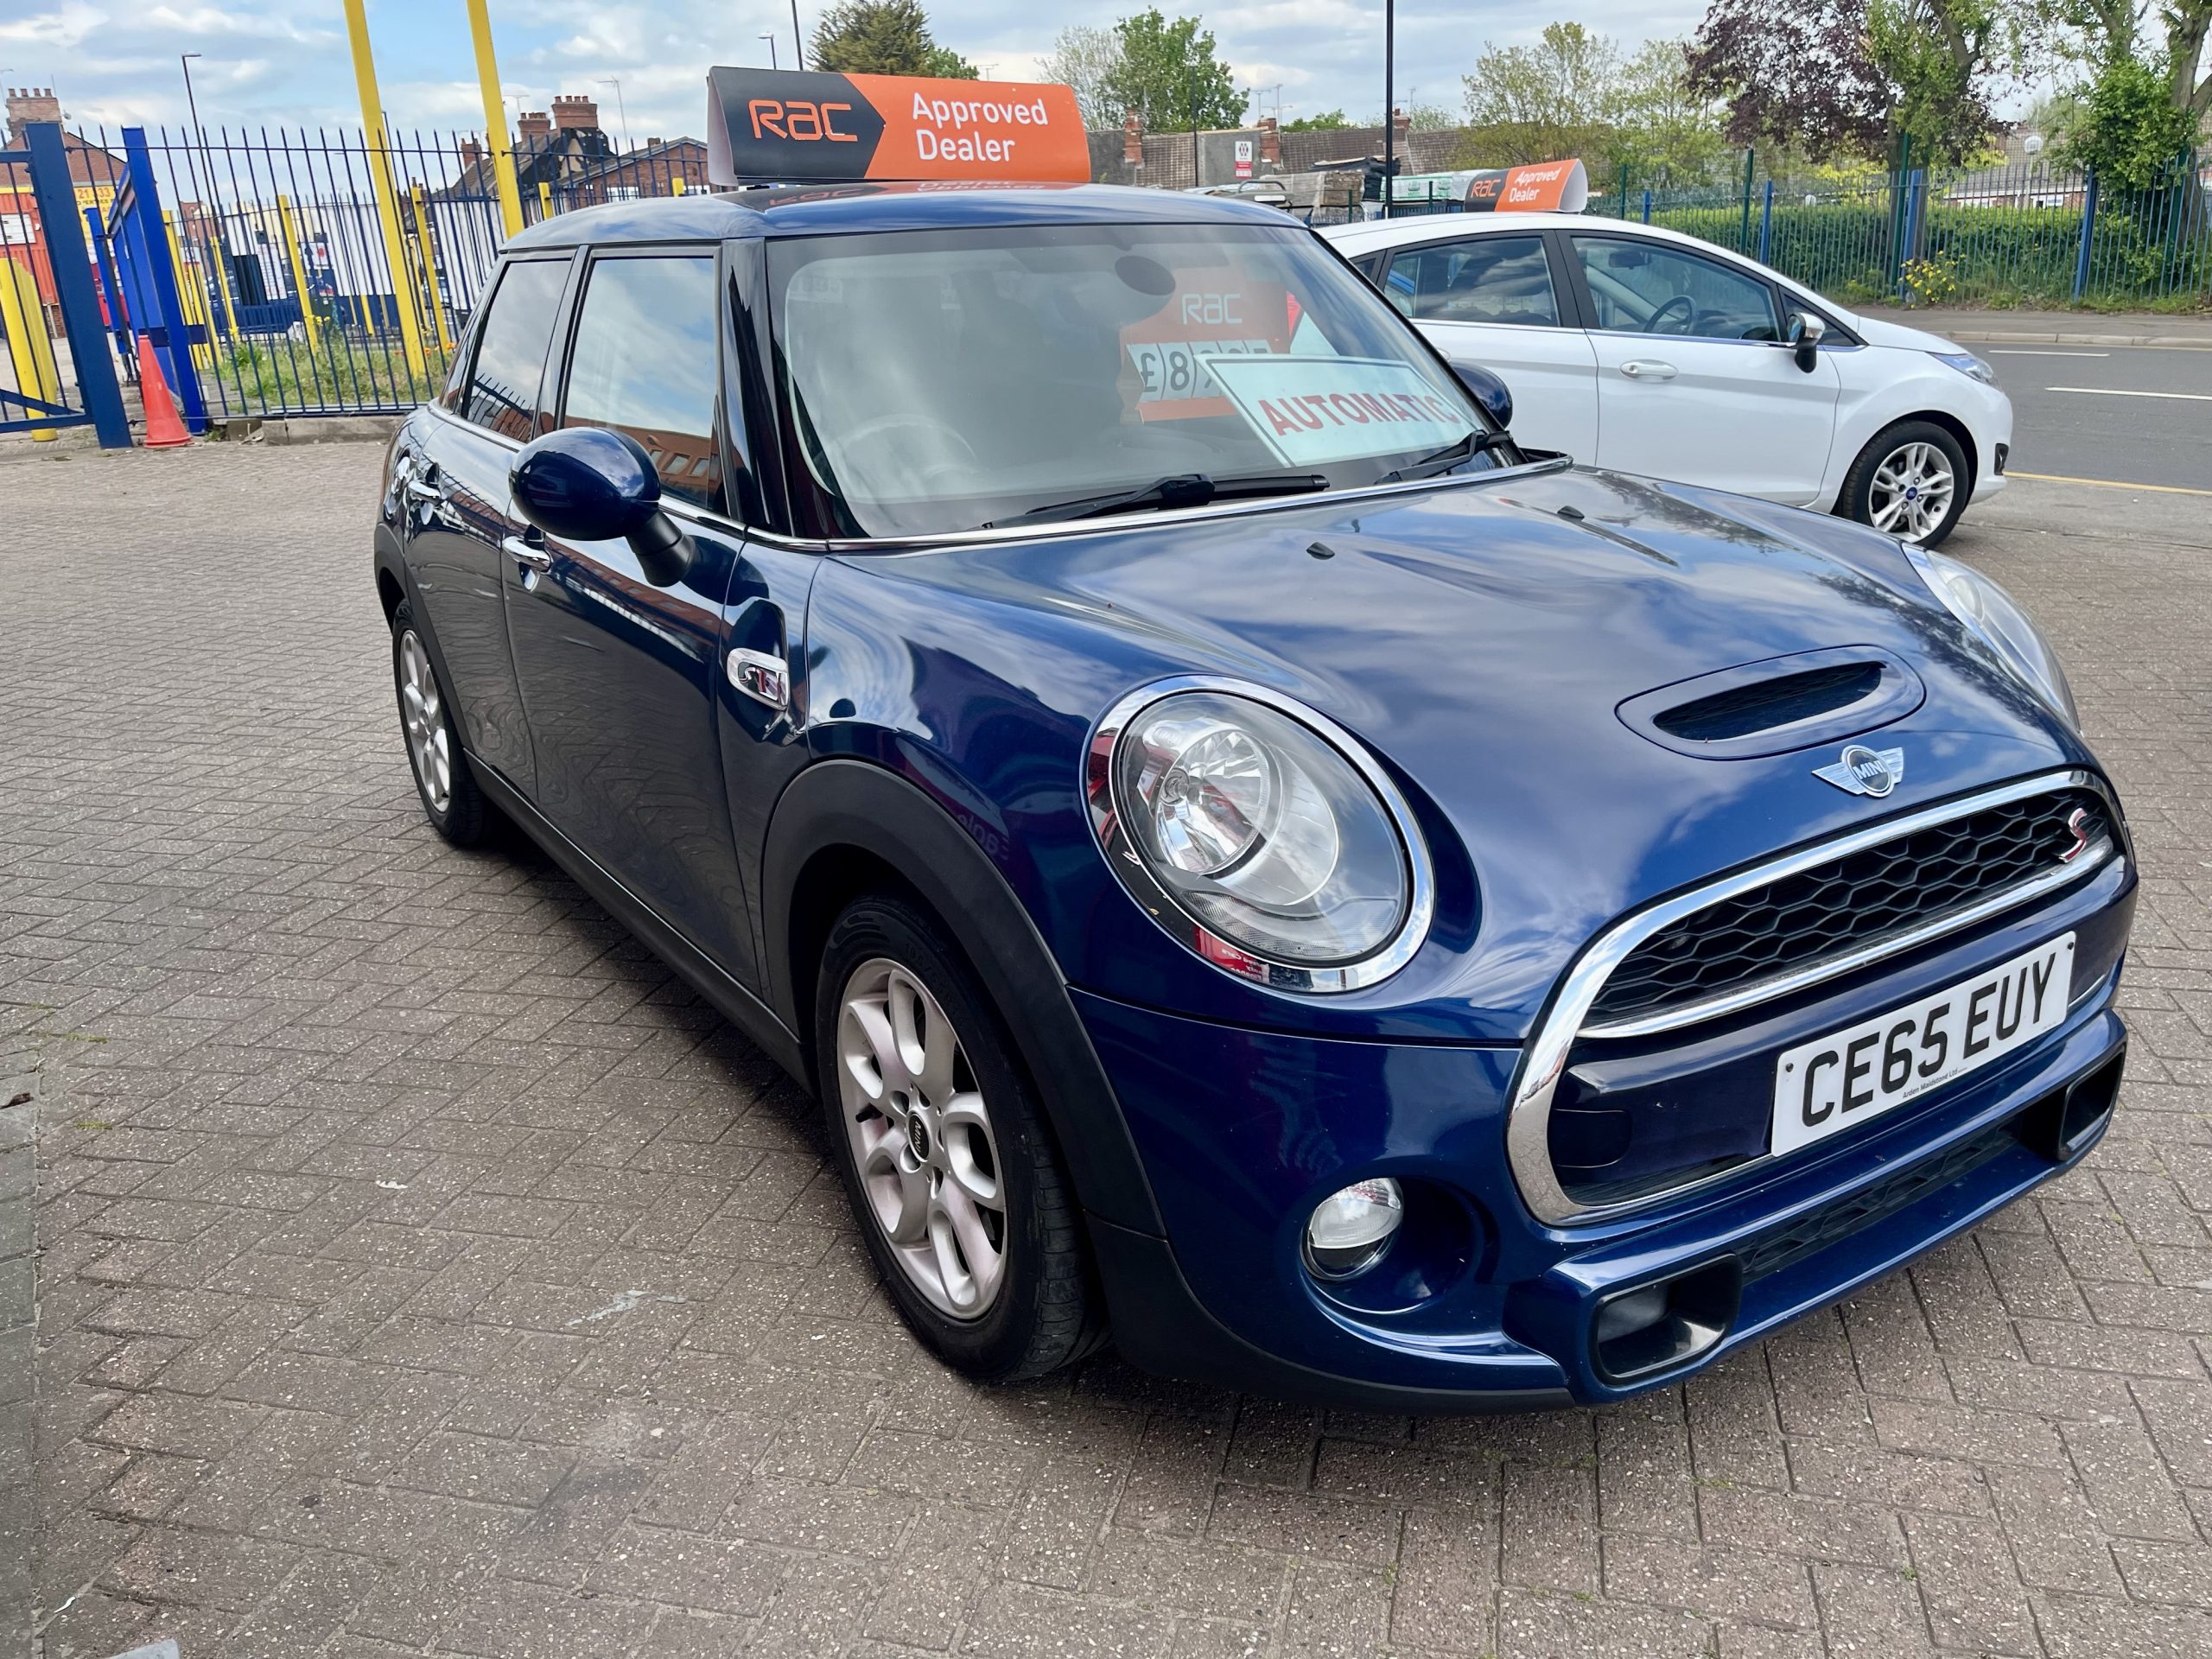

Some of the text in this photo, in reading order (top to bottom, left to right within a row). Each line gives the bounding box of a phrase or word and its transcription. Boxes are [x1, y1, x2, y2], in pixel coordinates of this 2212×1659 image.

[748, 99, 858, 143] RAC
[912, 92, 1049, 130] Approved
[916, 128, 1016, 162] Dealer
[1509, 188, 1540, 202] Dealer
[1514, 167, 1561, 187] Approved
[1258, 392, 1461, 436] AUTOMATIC
[1852, 760, 1887, 780] MINI
[2058, 807, 2088, 863] S
[1802, 952, 2056, 1128] CE65 EUY
